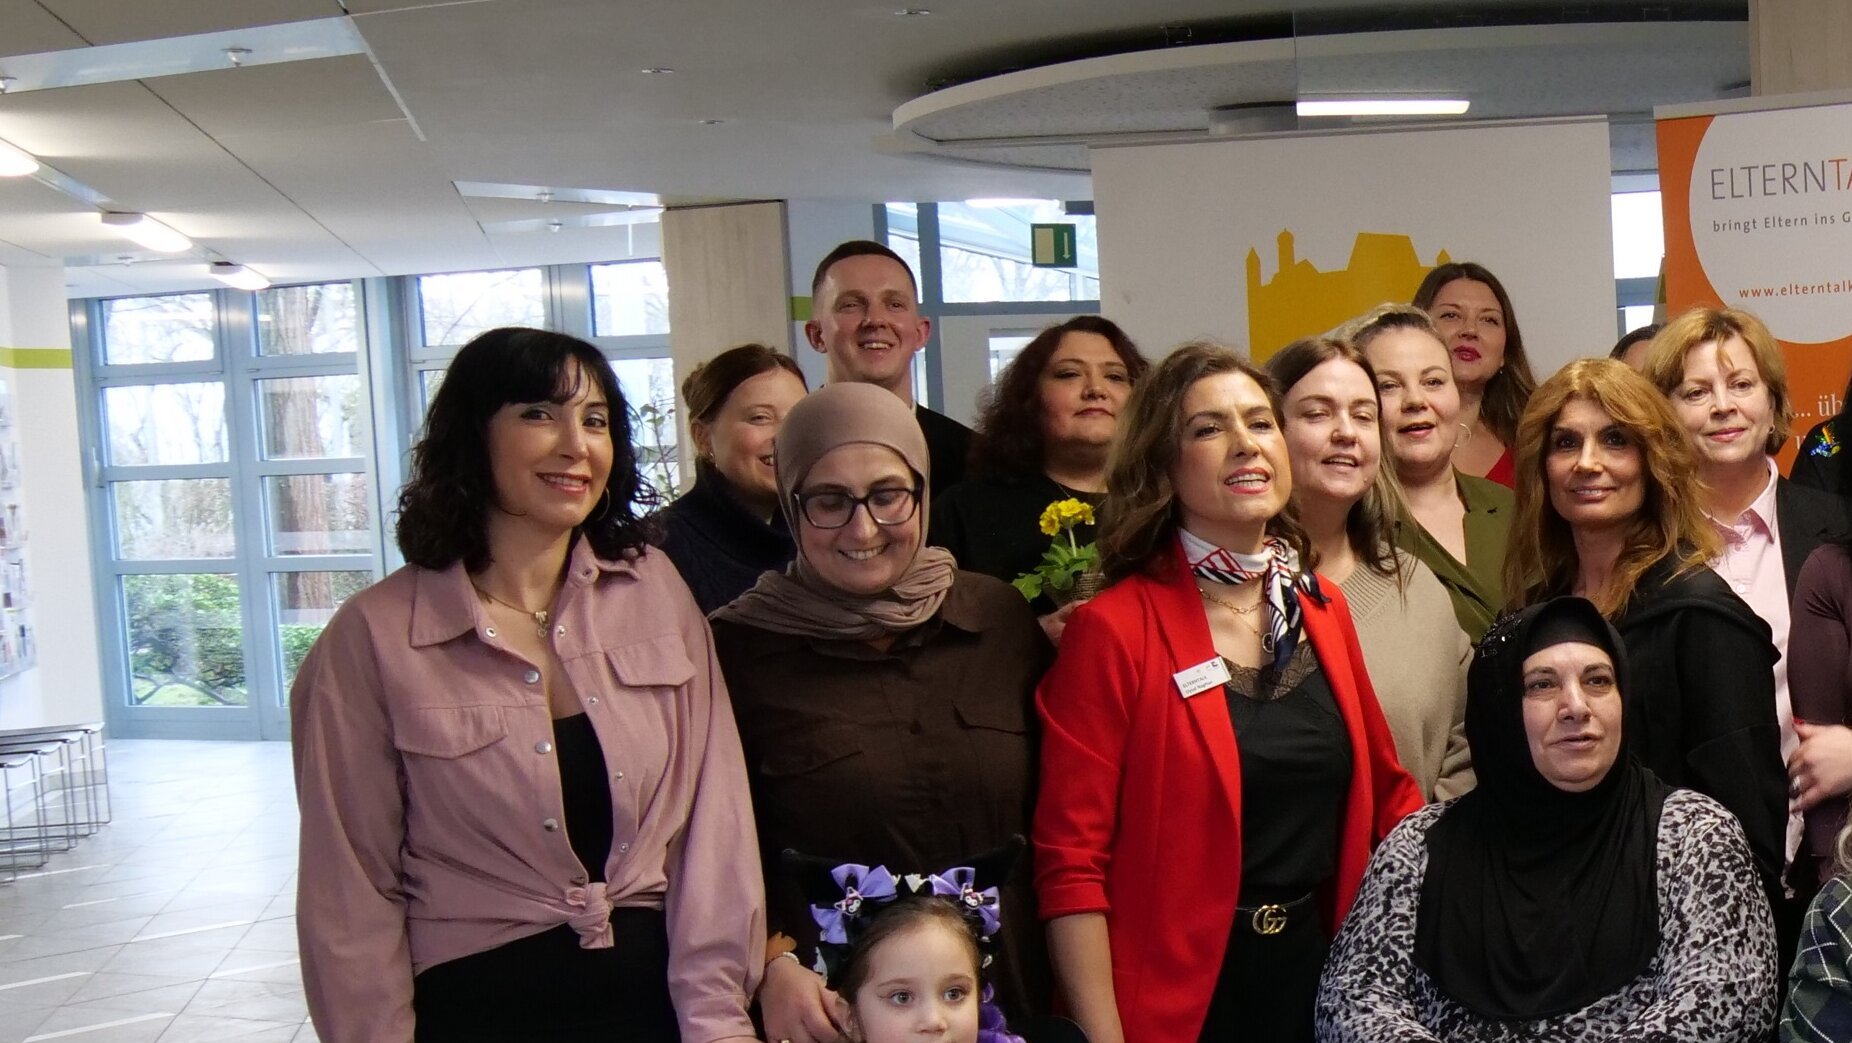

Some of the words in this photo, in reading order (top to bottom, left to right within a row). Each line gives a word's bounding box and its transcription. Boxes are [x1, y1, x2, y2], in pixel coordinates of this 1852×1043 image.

[1713, 218, 1758, 234] bringt
[1764, 214, 1808, 229] Eltern
[1814, 212, 1836, 226] ins
